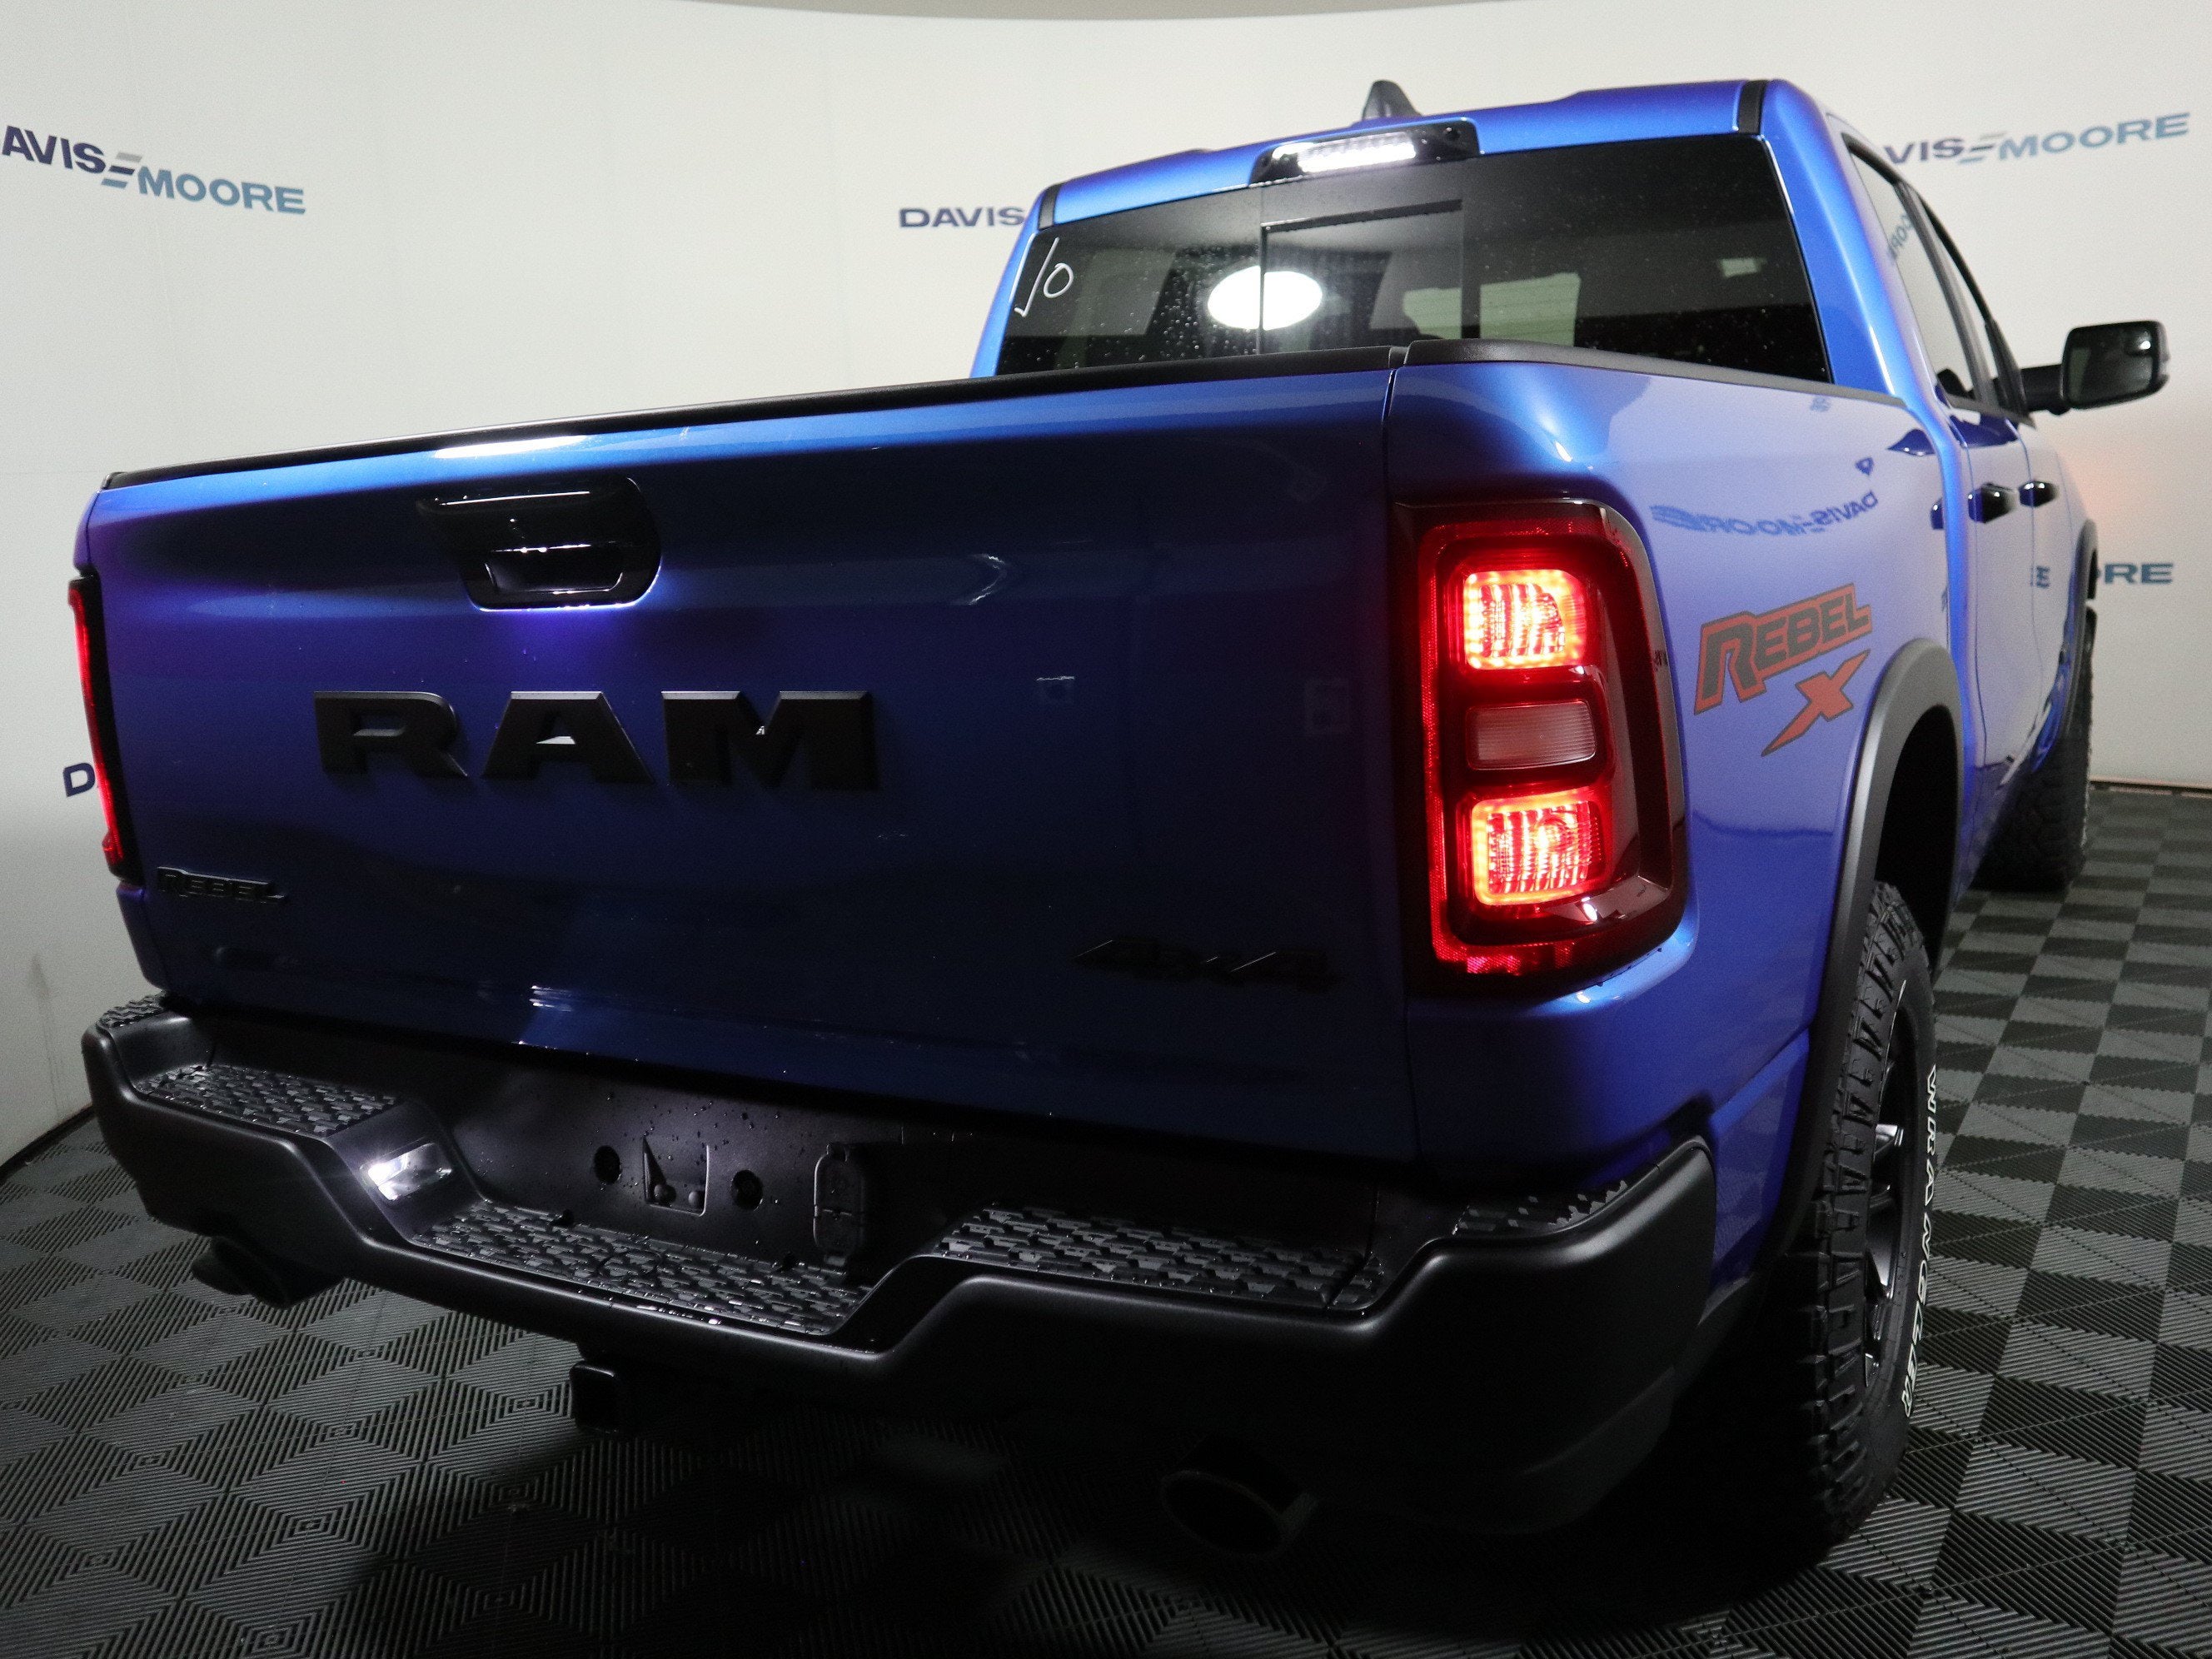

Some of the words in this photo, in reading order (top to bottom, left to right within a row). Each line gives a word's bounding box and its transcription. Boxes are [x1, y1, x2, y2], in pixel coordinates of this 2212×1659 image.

[1999, 112, 2190, 161] MOORE
[137, 166, 306, 215] MOORE
[899, 207, 1025, 227] DAVIS
[1694, 582, 1873, 715] REBEL
[314, 690, 876, 790] RAM
[1761, 649, 1871, 757] X
[1901, 1064, 1937, 1417] WRANGLER
